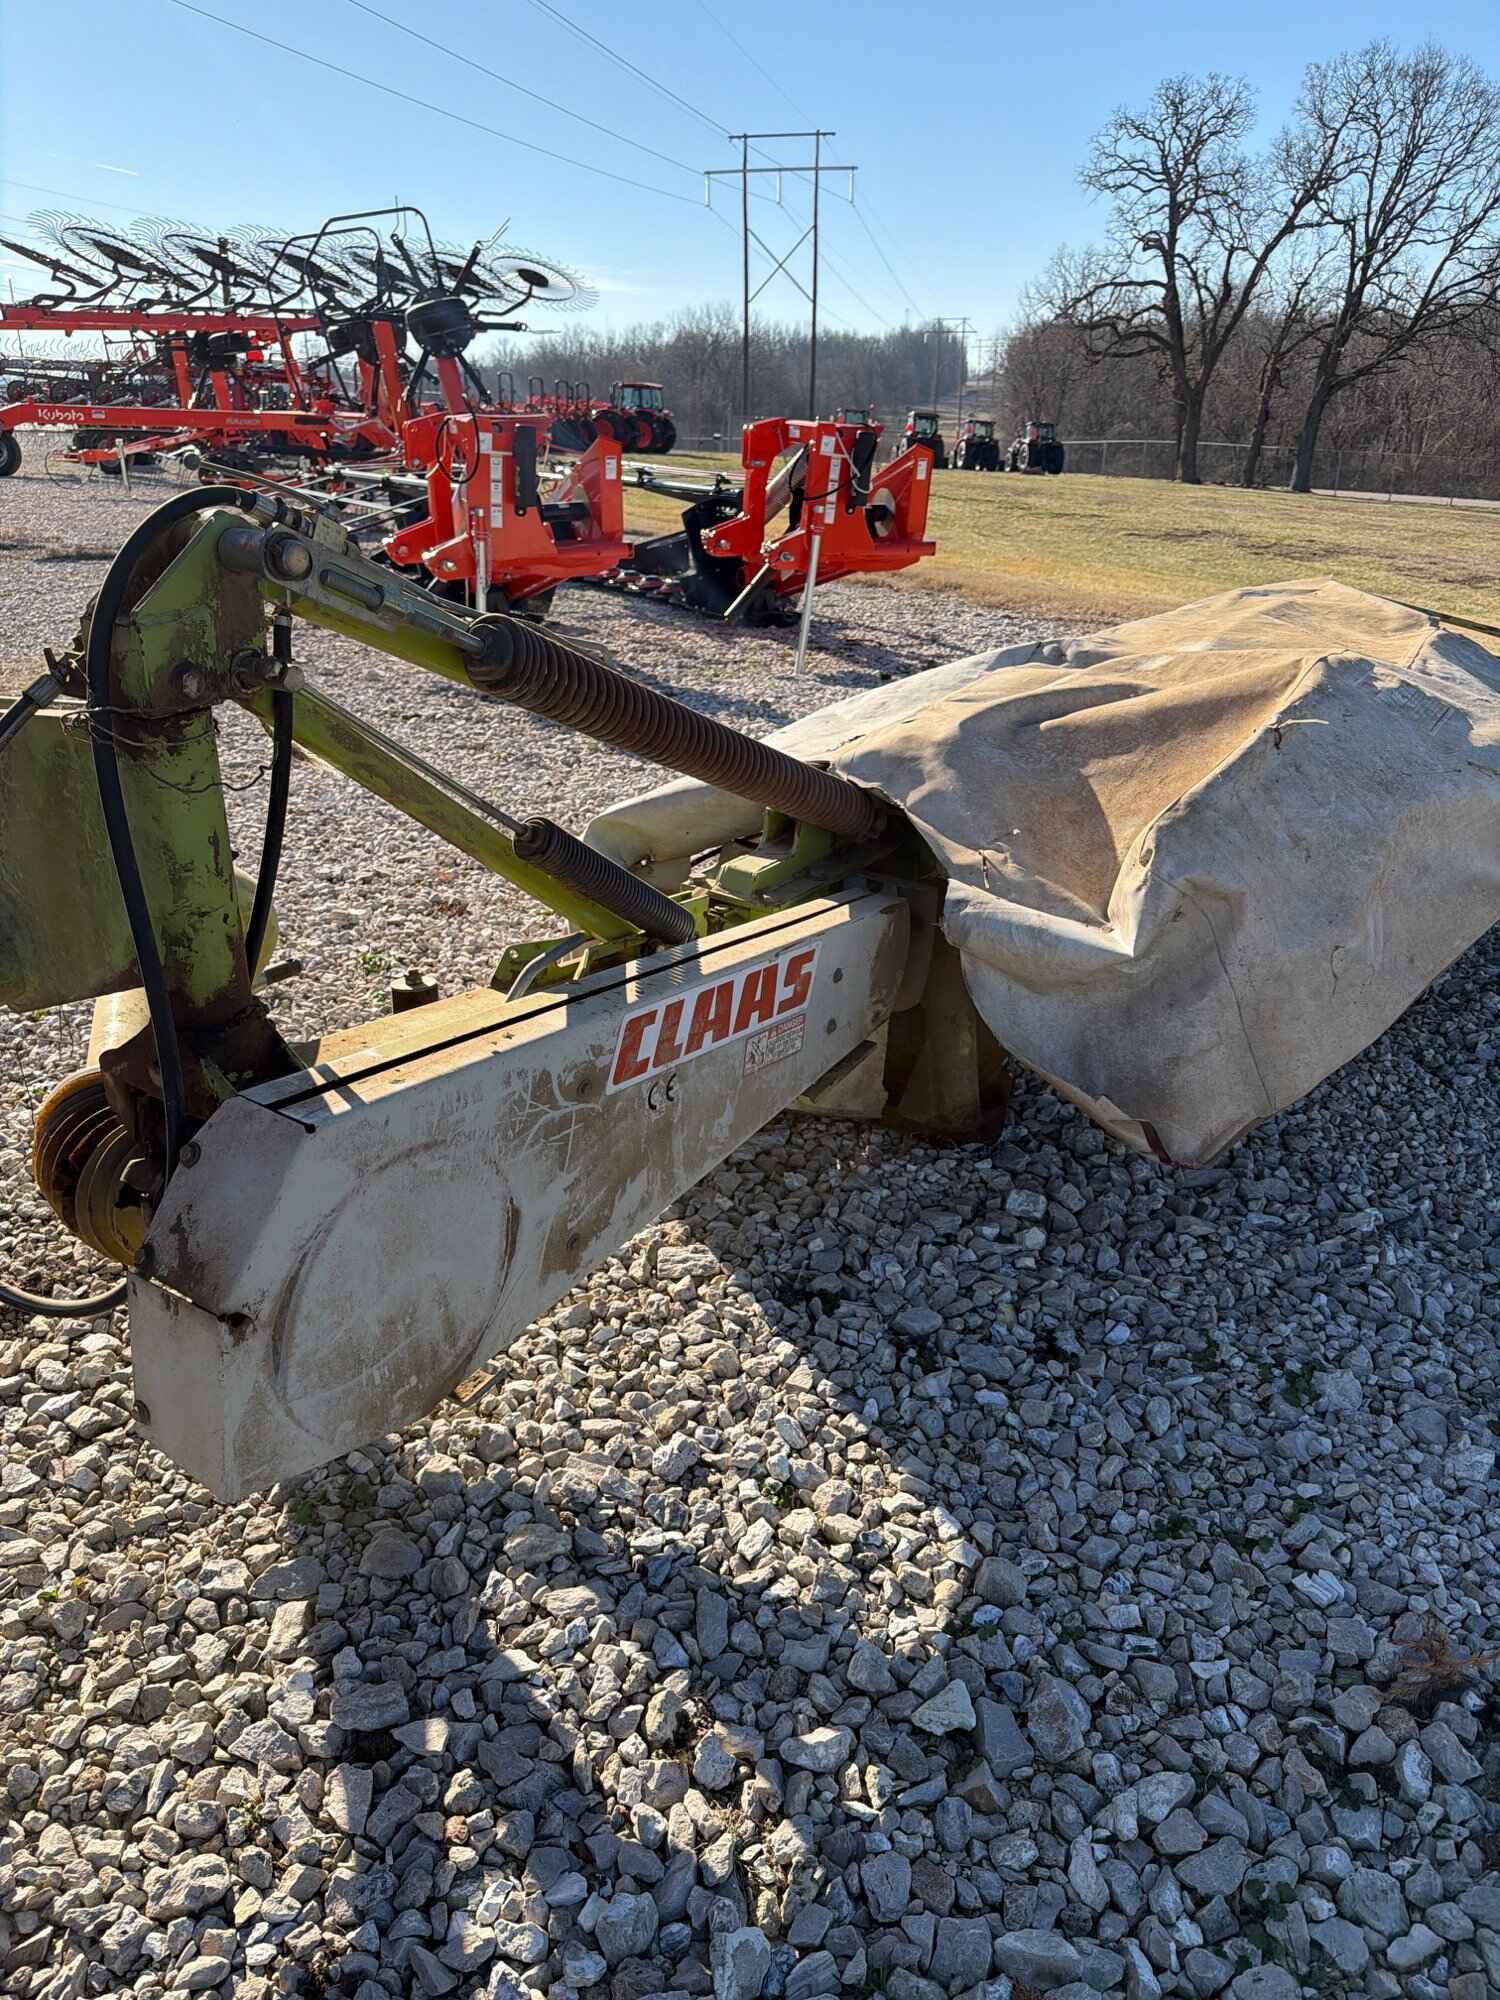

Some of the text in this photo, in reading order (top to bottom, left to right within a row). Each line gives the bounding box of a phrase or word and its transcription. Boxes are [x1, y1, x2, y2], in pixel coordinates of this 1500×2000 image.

[38, 408, 85, 421] Kubota
[612, 949, 816, 1086] CLAAS
[648, 1073, 677, 1111] CE
